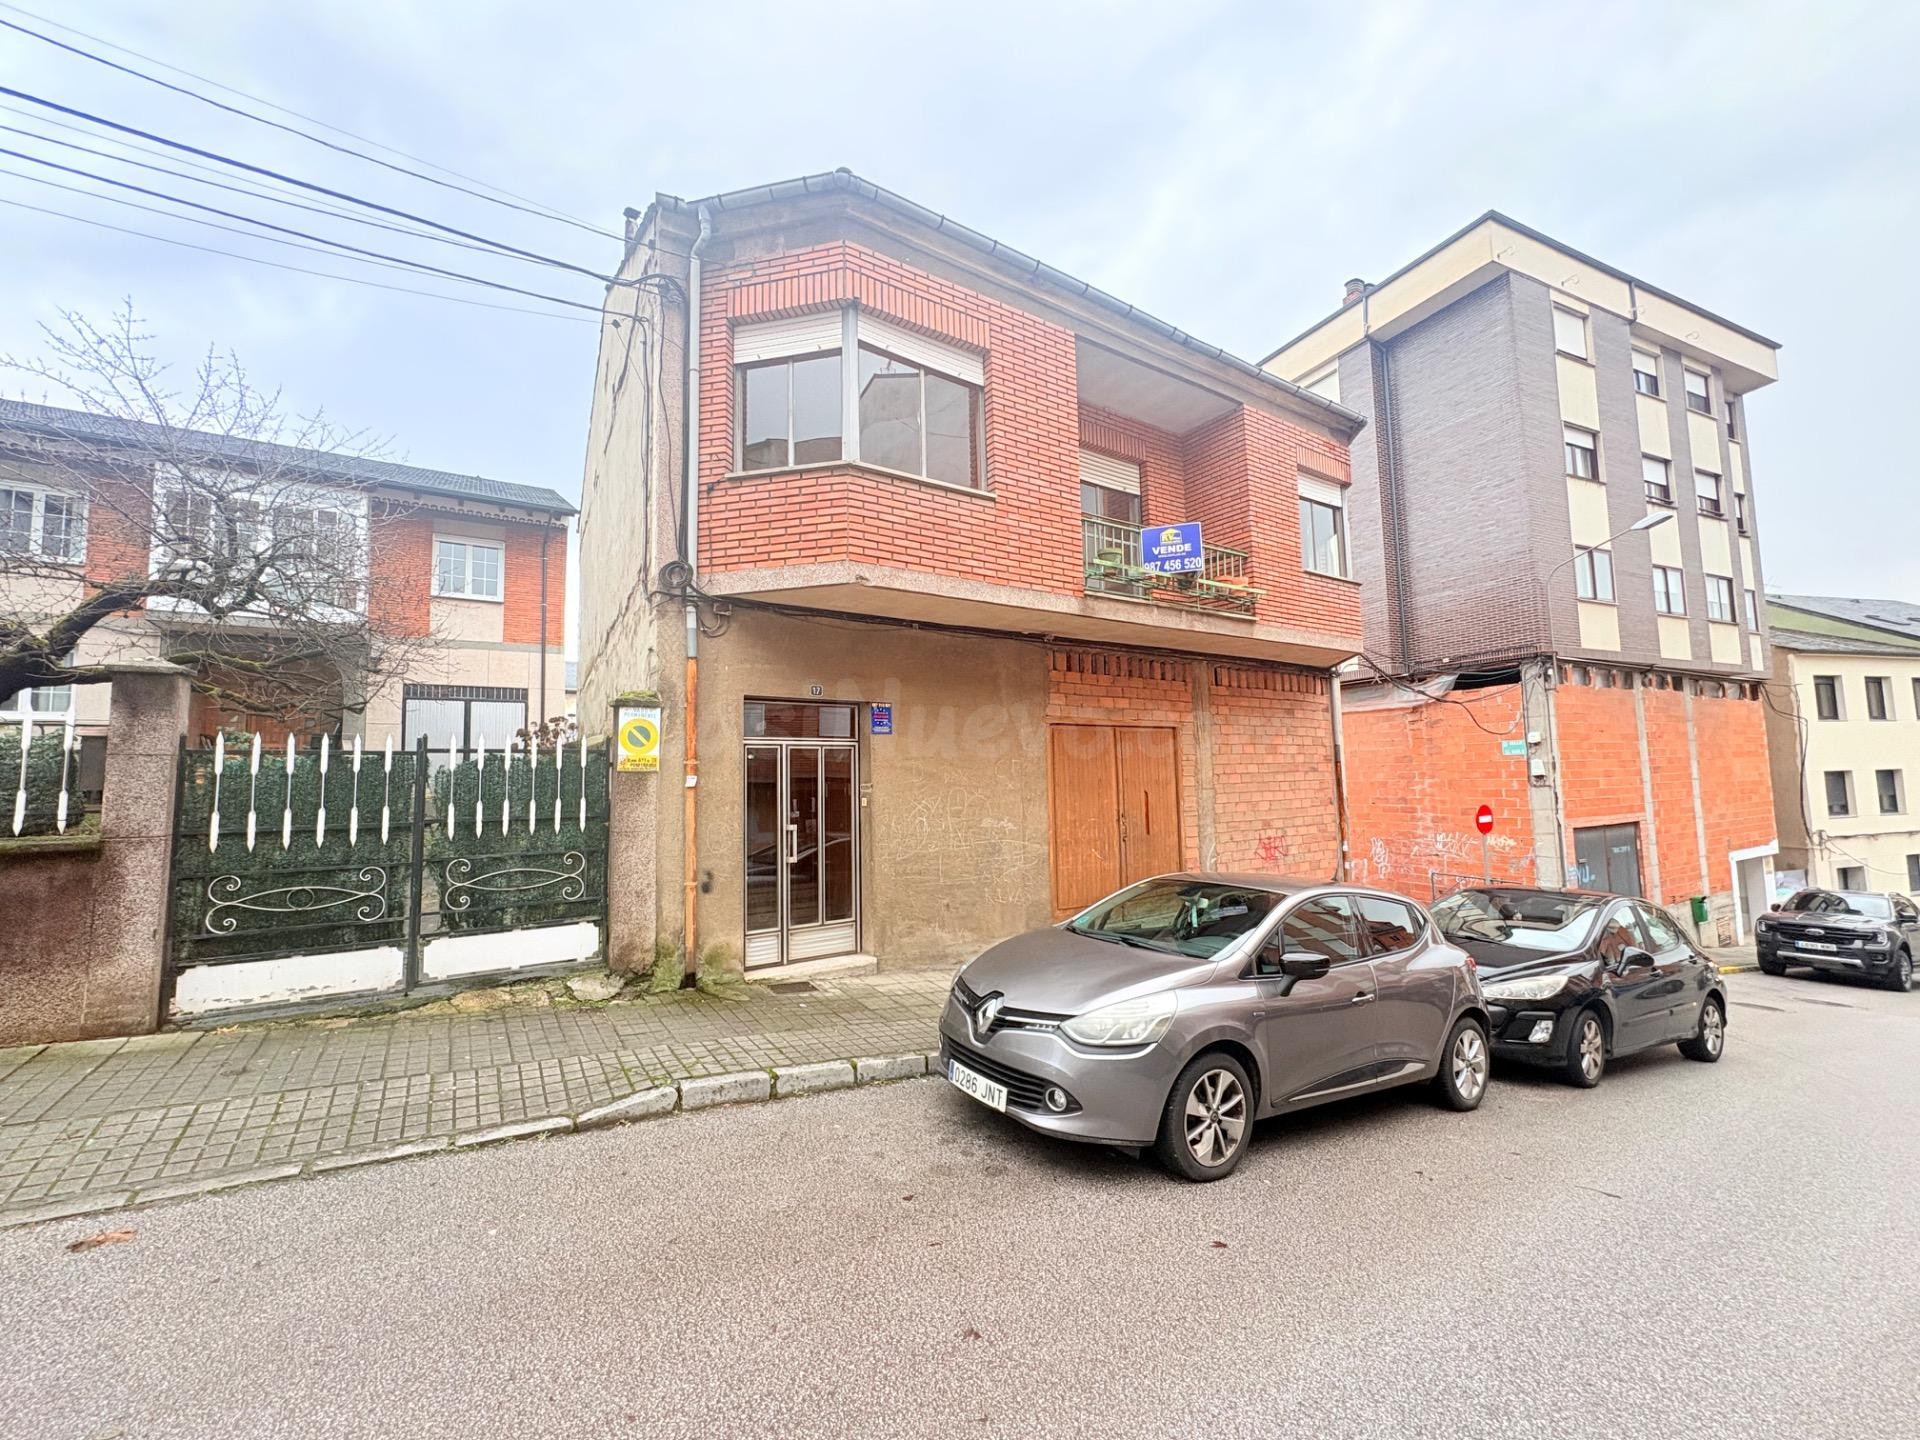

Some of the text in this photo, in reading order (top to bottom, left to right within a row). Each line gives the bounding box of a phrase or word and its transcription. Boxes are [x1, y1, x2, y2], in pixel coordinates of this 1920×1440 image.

[1152, 543, 1192, 555] VENDE
[1163, 559, 1182, 571] 456
[1184, 556, 1201, 569] 520
[812, 687, 821, 695] 17
[955, 1066, 1003, 1106] 0286 JNT
